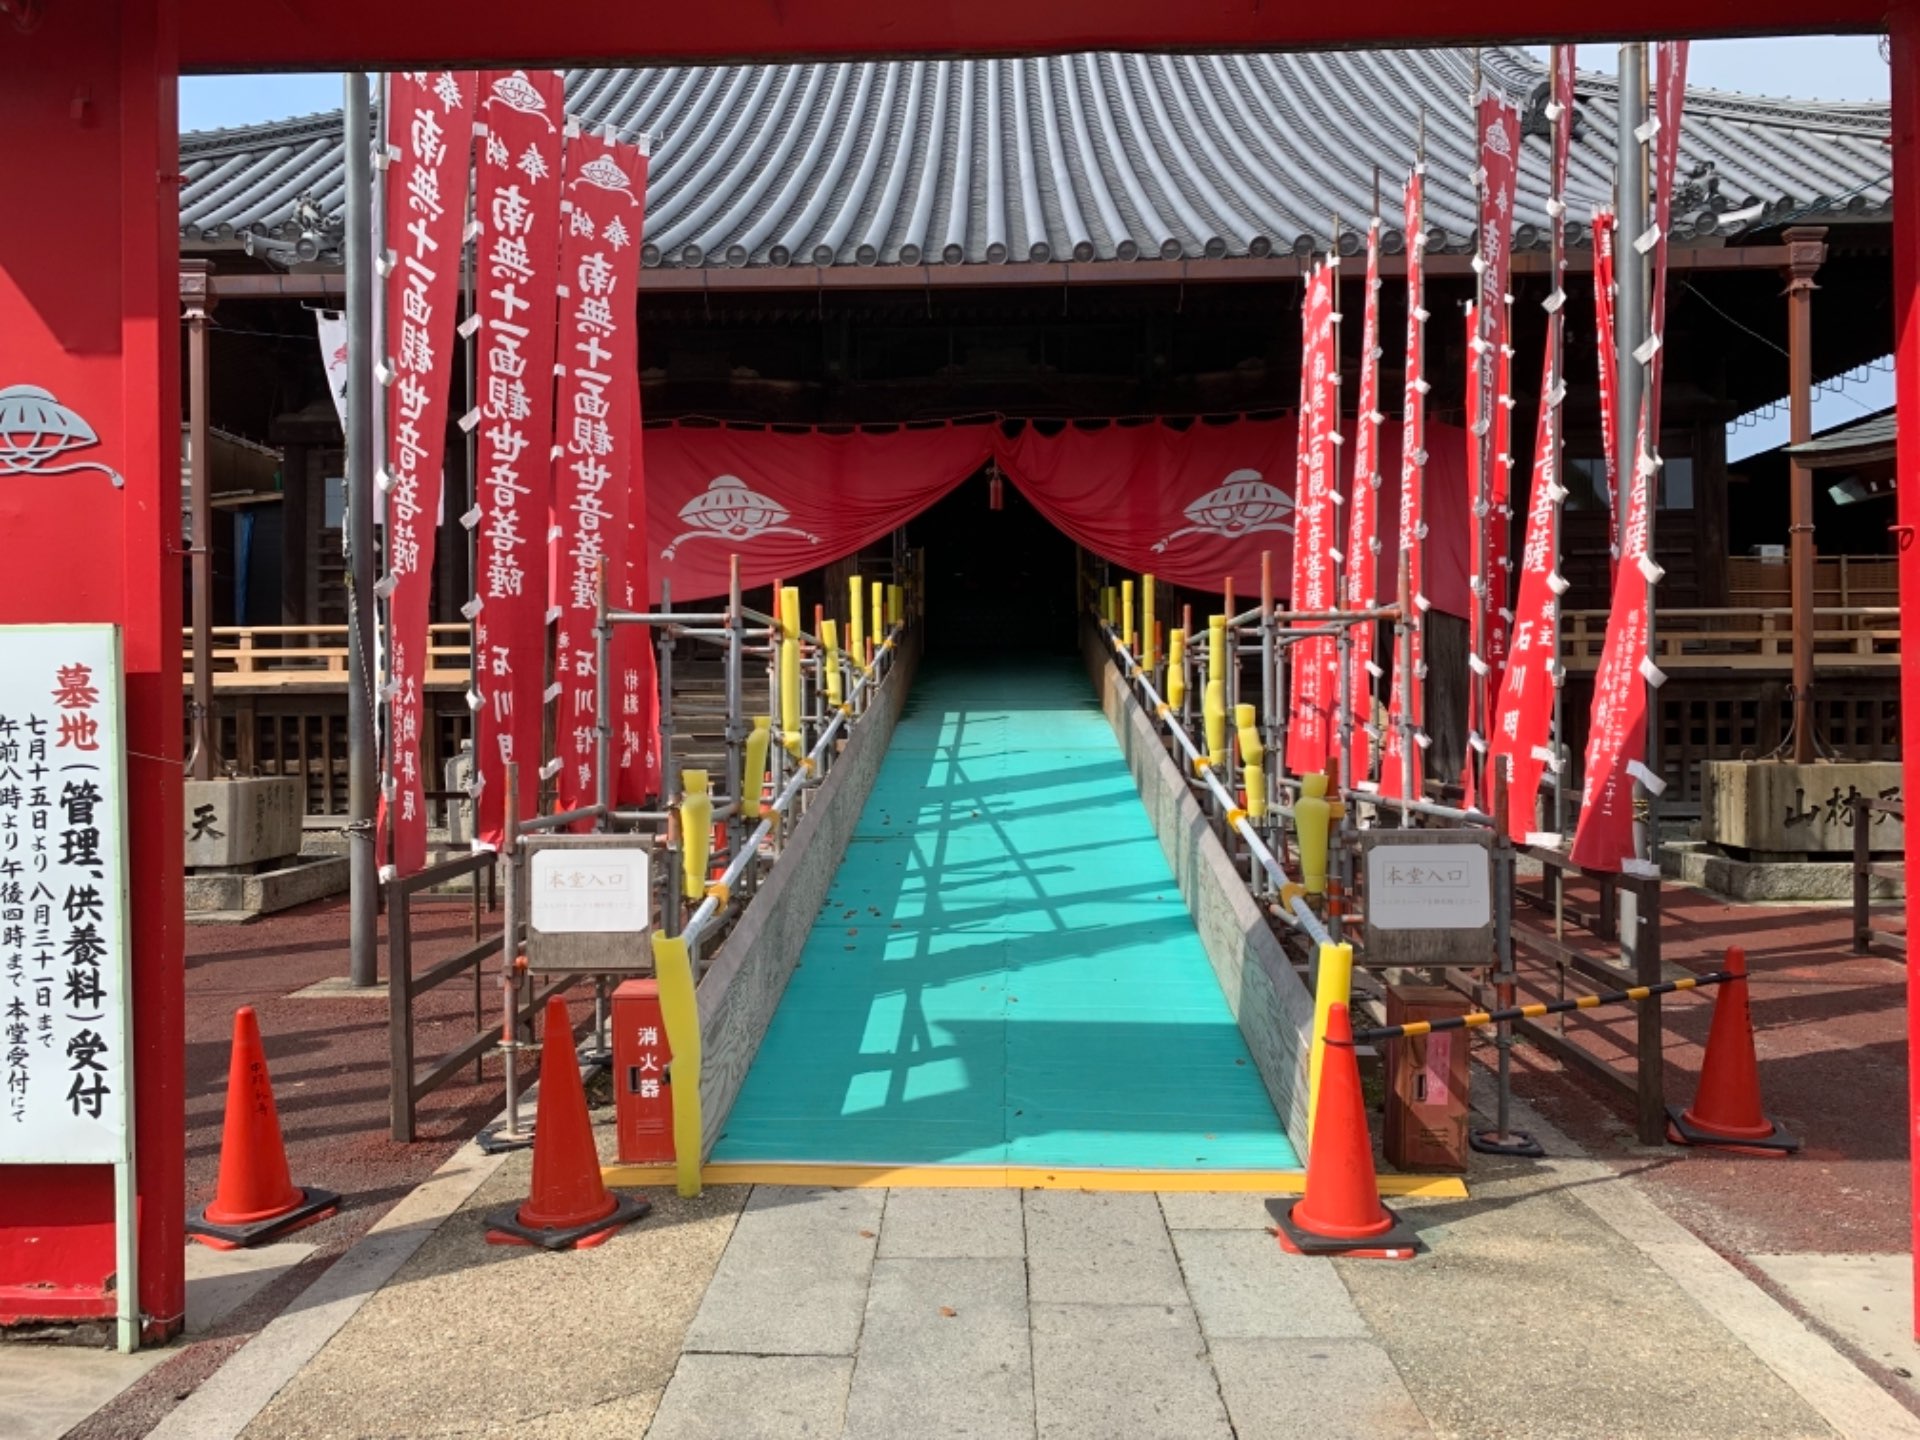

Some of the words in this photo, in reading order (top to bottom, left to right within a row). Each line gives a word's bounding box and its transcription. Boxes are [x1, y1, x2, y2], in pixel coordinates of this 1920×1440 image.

[549, 870, 623, 889] 本堂入口
[1387, 864, 1464, 886] 本堂入口
[637, 1026, 661, 1098] 消火器
